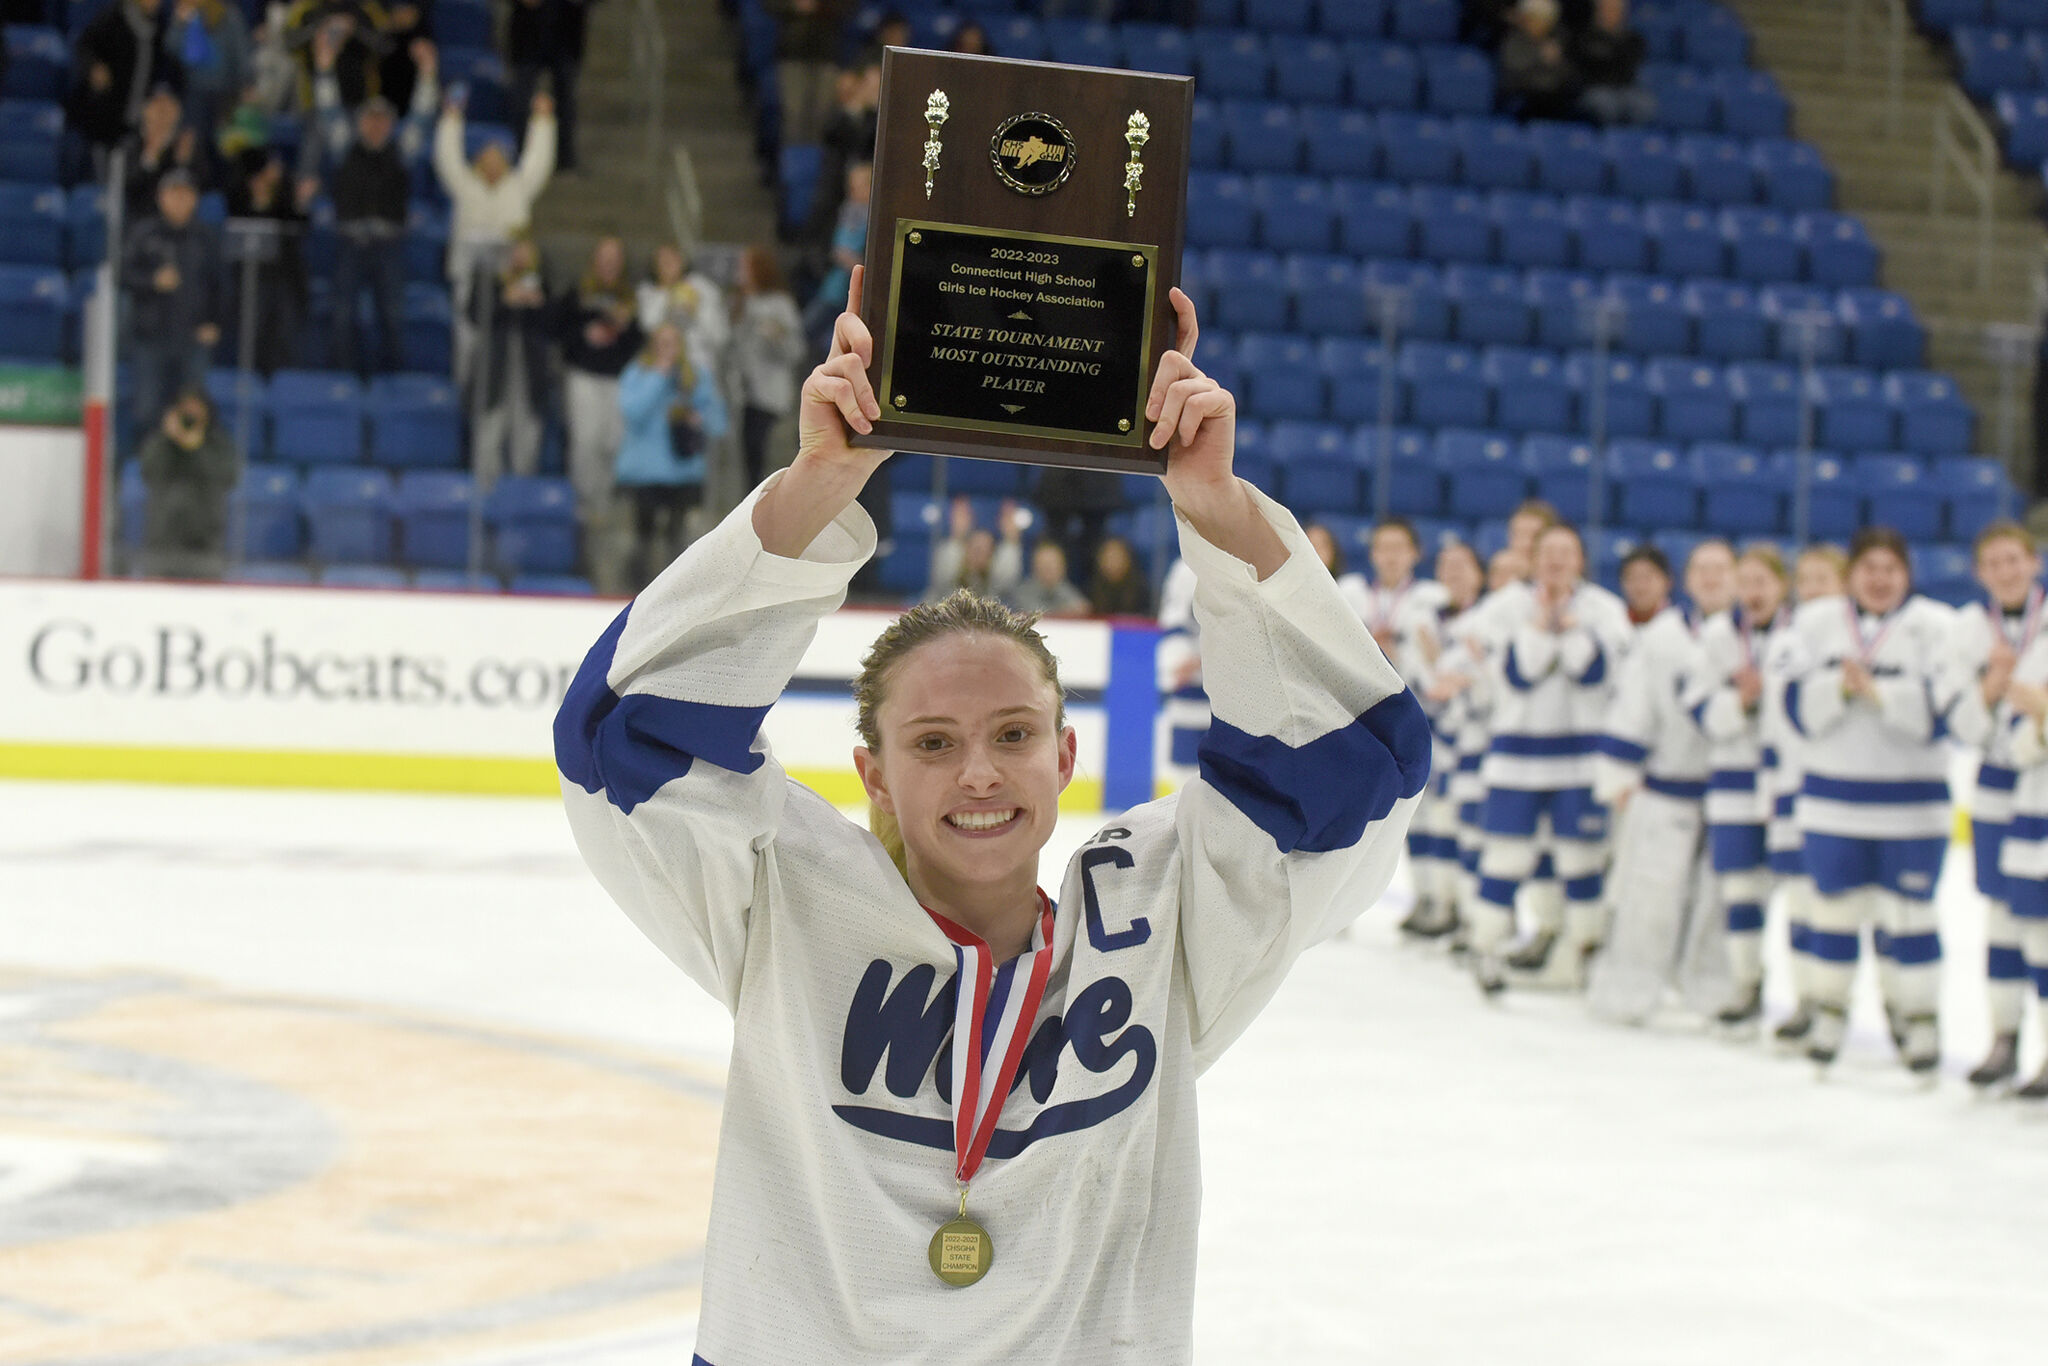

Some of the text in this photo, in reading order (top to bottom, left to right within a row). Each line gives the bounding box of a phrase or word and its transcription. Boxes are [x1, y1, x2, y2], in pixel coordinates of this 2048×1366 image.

[990, 248, 1060, 265] 2022-2023
[951, 263, 1096, 289] Connecticut High School
[938, 281, 1105, 309] Girls Ice Hockey Association
[931, 323, 1105, 353] STATE TOURNAMENT
[929, 346, 1102, 376] MOST OUTSTANDING
[981, 375, 1046, 394] PLAYER
[1081, 845, 1151, 953] C
